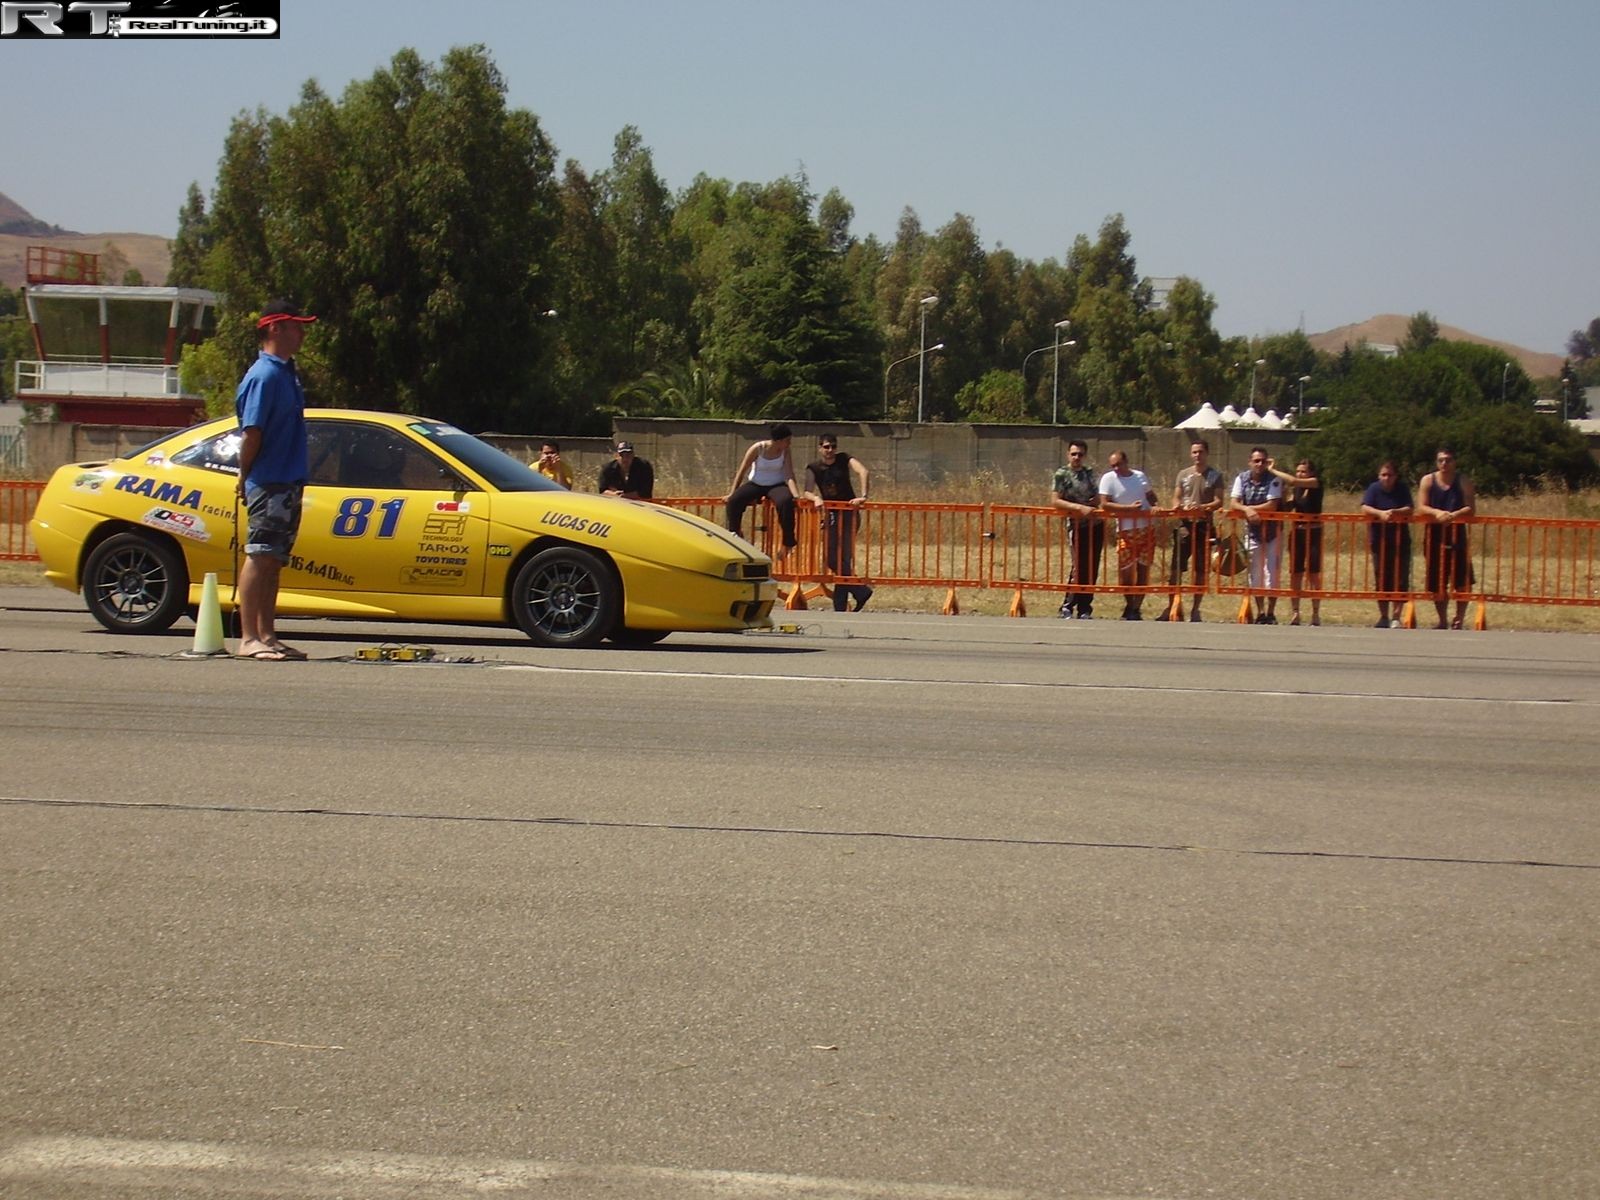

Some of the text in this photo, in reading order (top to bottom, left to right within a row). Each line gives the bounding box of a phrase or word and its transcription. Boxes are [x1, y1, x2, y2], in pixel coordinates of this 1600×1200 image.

[115, 475, 203, 510] RAMA
[332, 496, 407, 539] 81
[540, 511, 612, 538] LUCAS OIL
[416, 556, 468, 566] TOYO TIRES
[491, 547, 511, 555] OMP
